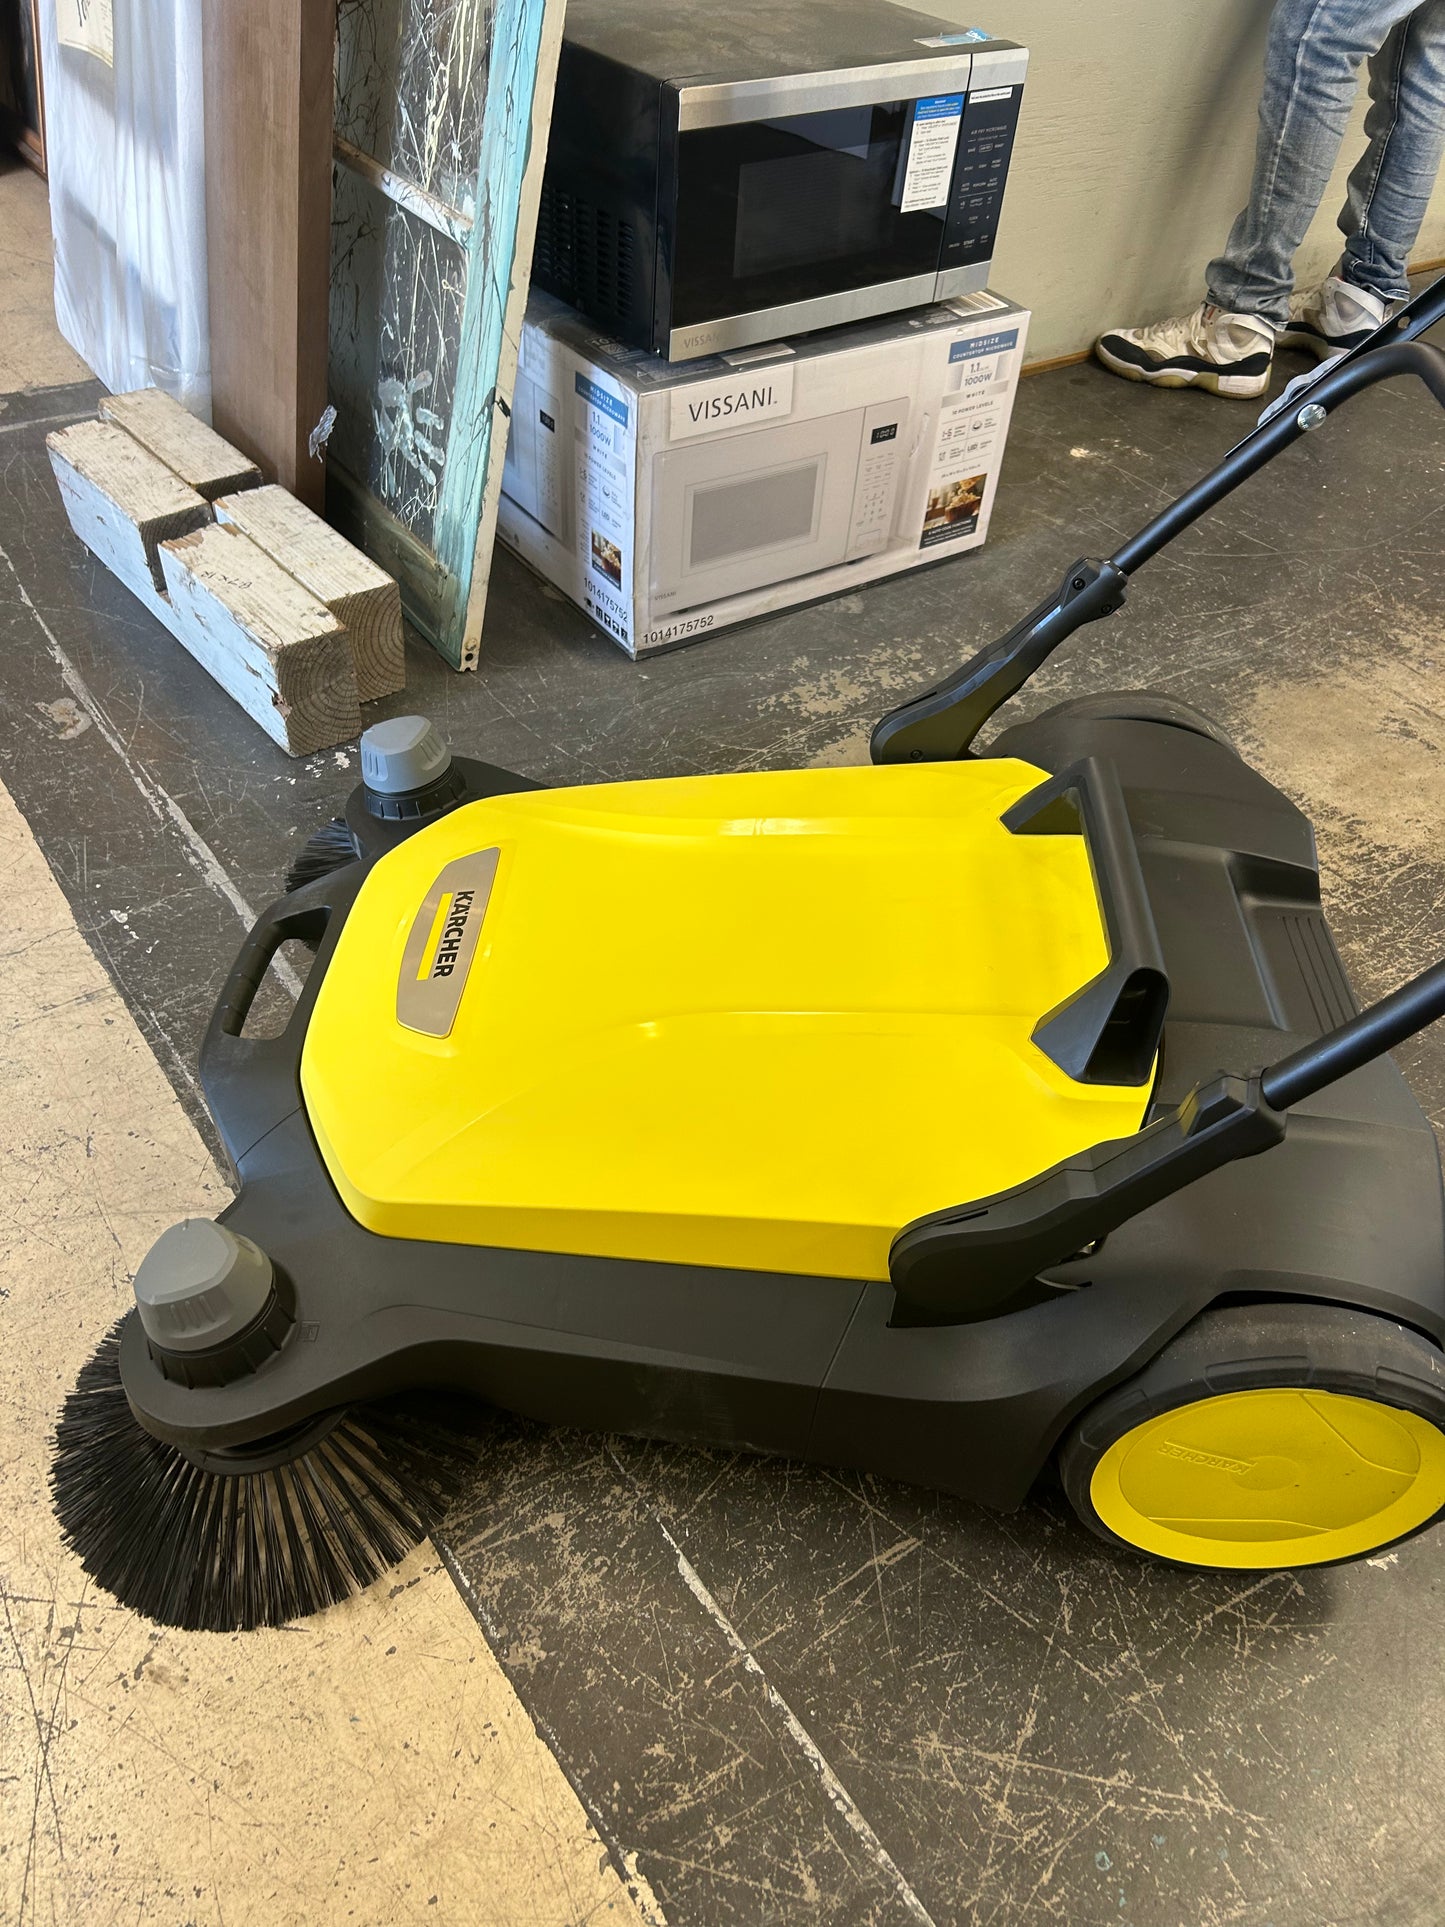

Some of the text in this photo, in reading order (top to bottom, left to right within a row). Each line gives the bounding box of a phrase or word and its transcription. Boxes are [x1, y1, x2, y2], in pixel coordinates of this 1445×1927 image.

[684, 332, 722, 349] VISSAN
[970, 337, 999, 349] MIDSIZE
[952, 341, 1014, 360] COUNTERTOP MICROWAVE
[970, 362, 980, 374] 1.1
[964, 373, 992, 386] 1000W
[590, 384, 613, 407] MIDSIZE
[966, 390, 985, 399] WHITE
[688, 386, 772, 422] VISSANI
[592, 411, 600, 425] 1.1
[590, 424, 611, 446] 1000W
[583, 577, 628, 622] 1014175752
[643, 615, 714, 644] 1014175752
